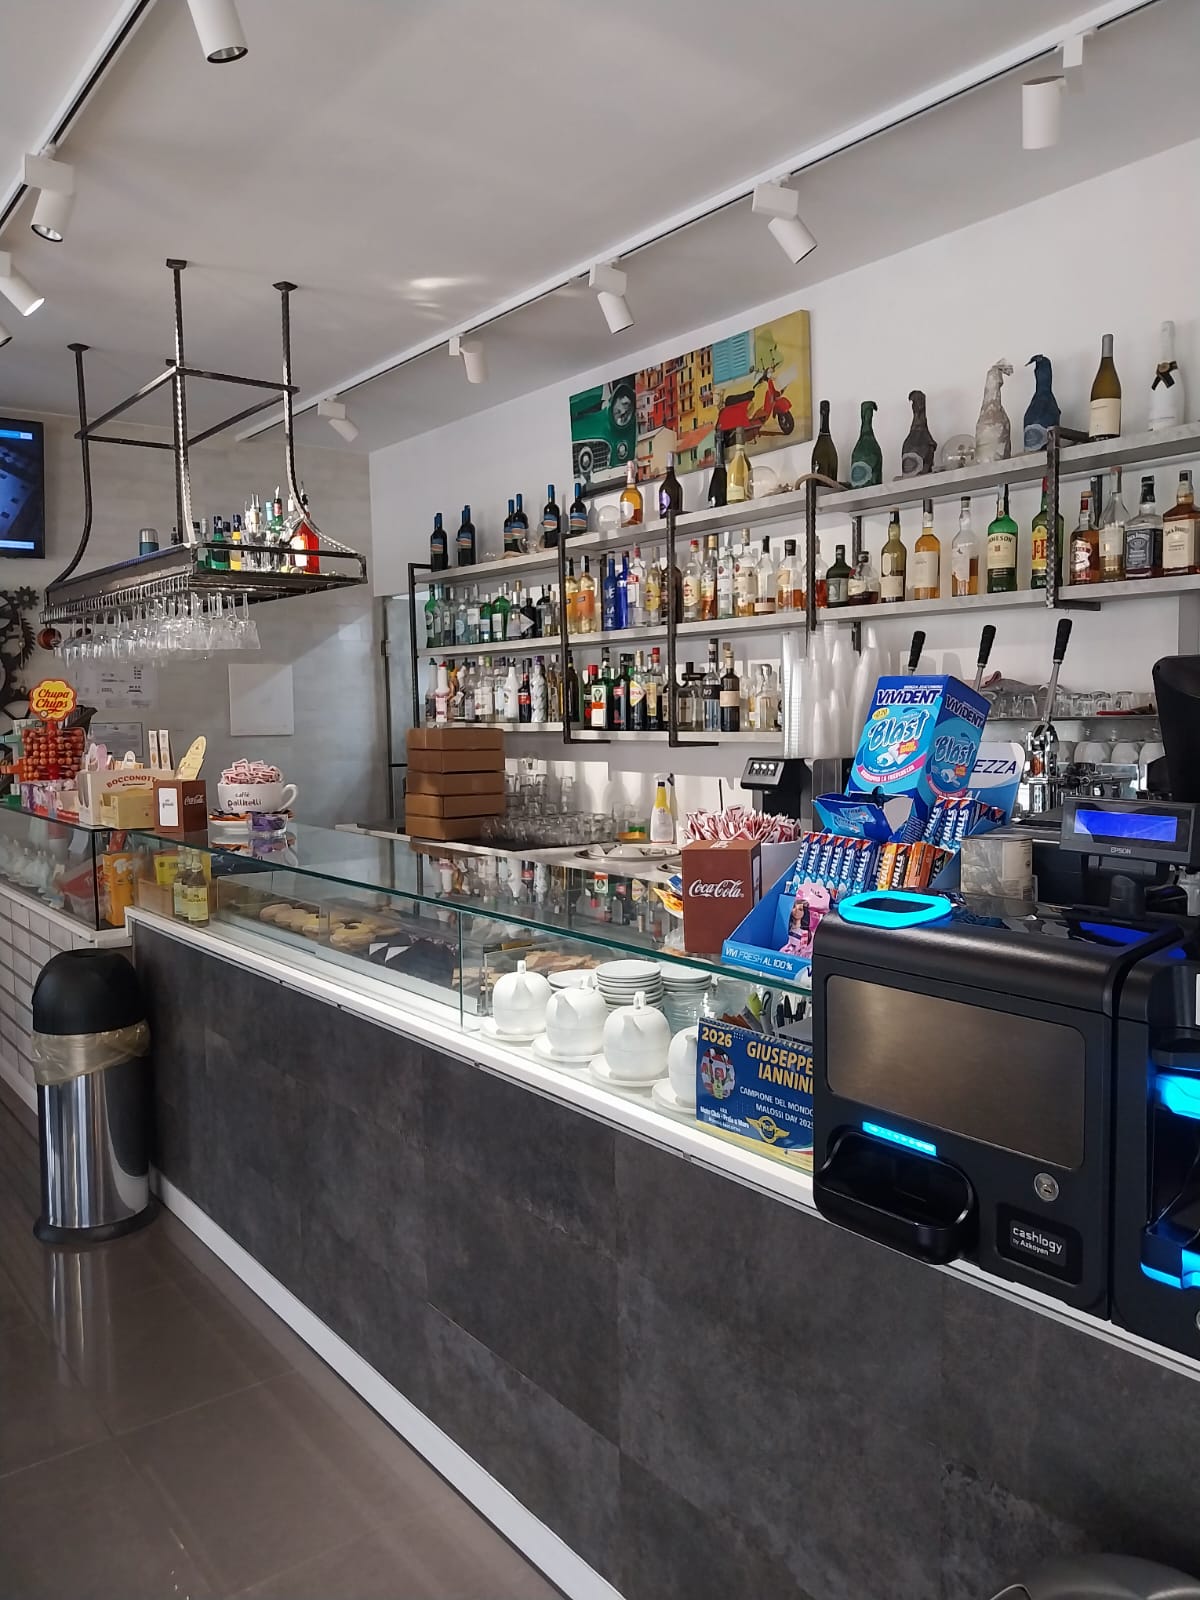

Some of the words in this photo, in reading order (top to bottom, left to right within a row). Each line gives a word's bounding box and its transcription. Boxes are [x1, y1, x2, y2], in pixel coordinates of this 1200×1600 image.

[36, 697, 68, 712] Chups
[38, 688, 69, 700] Chupa
[868, 709, 930, 751] Blast
[934, 735, 976, 767] Blast
[924, 806, 942, 837] HALLS
[942, 809, 957, 841] HALLS
[954, 809, 969, 841] HALLS
[796, 842, 808, 872] HALLS
[806, 843, 818, 873] HALLS
[818, 845, 831, 876] HALLS
[829, 847, 842, 878] HALLS
[841, 849, 854, 880] HALLS
[856, 851, 870, 882] HALLS
[880, 853, 891, 884] HALLS
[892, 854, 905, 888] HALLS
[688, 879, 745, 899] Coca-Cola
[762, 957, 772, 966] AL
[773, 960, 793, 971] 100%
[701, 1027, 732, 1048] 2026
[747, 1041, 813, 1076] GIUSEPPE
[758, 1063, 813, 1094] IANNINI
[740, 1086, 774, 1103] CAMPIONE
[775, 1097, 787, 1107] DEL
[756, 1104, 784, 1119] MALOSSI
[785, 1113, 799, 1124] DAY
[1012, 1226, 1063, 1254] cashlogy
[1020, 1240, 1049, 1256] Azkoyen
